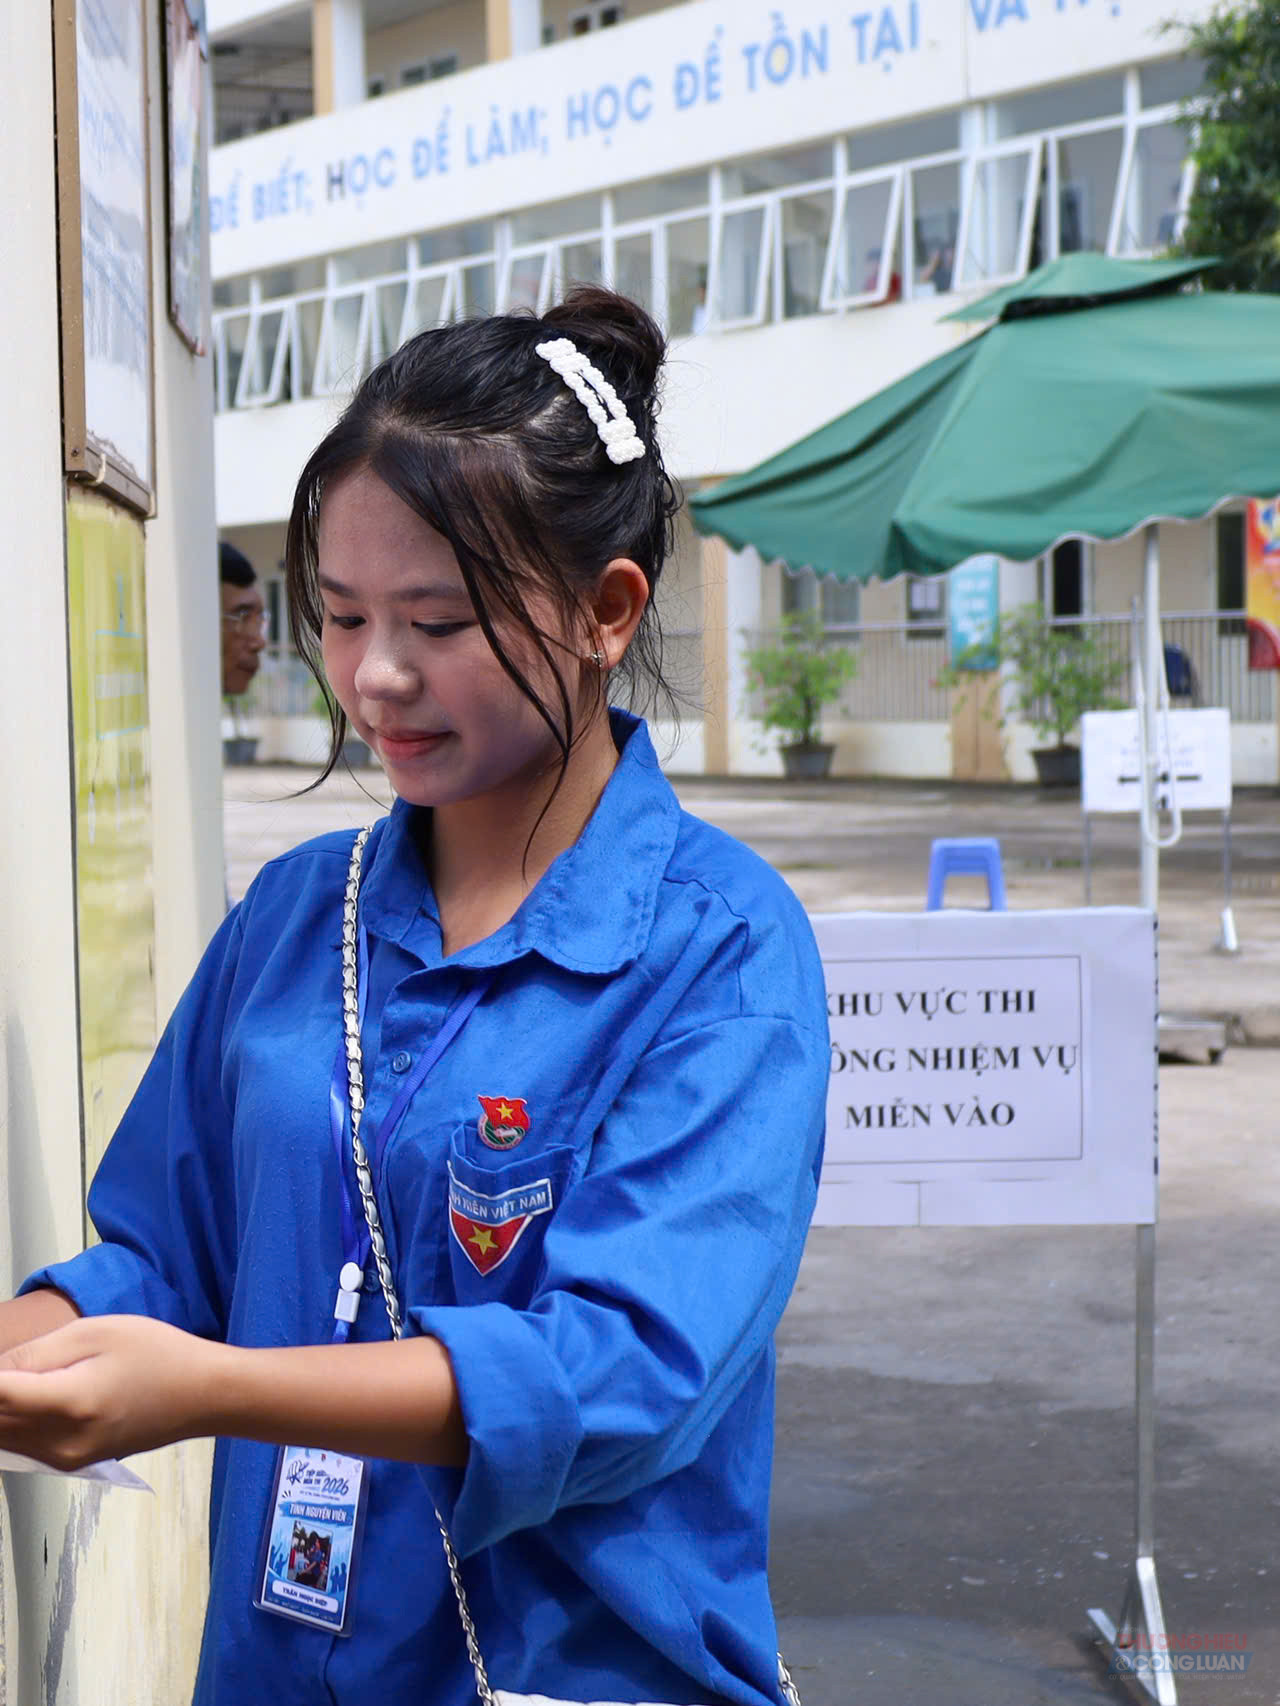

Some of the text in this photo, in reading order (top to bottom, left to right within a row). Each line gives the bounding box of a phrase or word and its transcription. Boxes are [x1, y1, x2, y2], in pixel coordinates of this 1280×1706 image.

[326, 147, 396, 210] HỌC
[567, 75, 653, 146] HỌC
[742, 11, 828, 91] TỒN
[850, 0, 918, 72] TẠI
[895, 987, 968, 1021] VỰC
[977, 990, 1037, 1014] THI
[907, 1044, 1022, 1077] NHIỆM
[1031, 1045, 1078, 1075] VỤ
[943, 1096, 1016, 1127] VÀO
[520, 1192, 546, 1209] NAM
[321, 1476, 349, 1496] 2026
